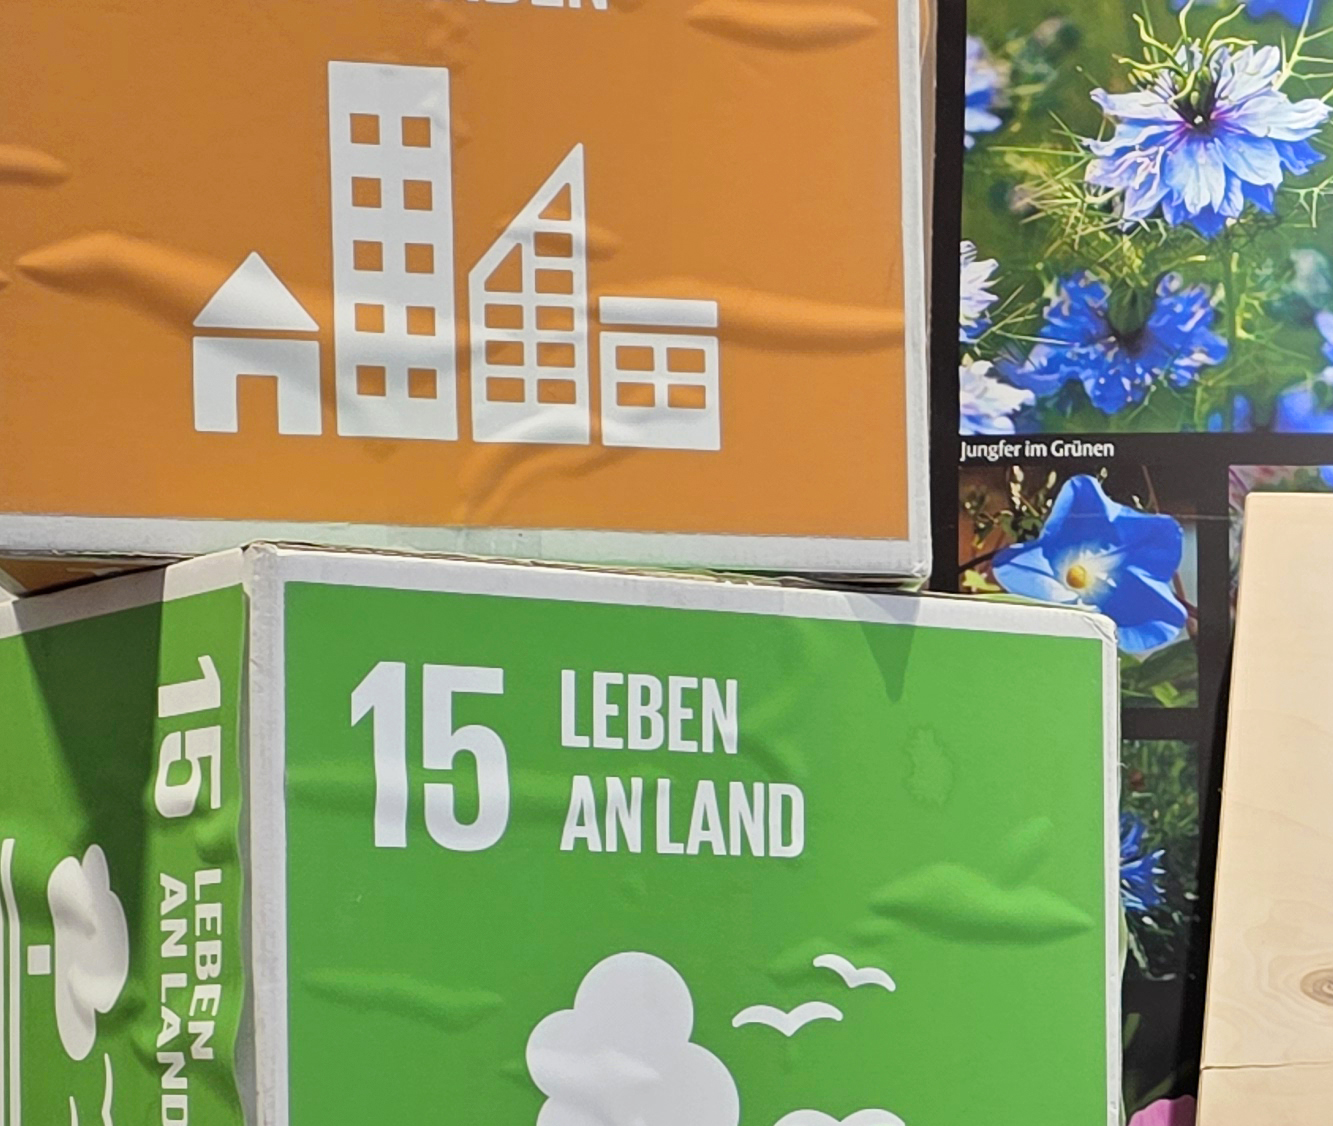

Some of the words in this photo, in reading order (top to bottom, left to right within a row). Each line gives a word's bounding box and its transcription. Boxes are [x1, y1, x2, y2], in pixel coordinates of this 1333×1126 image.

[960, 440, 1022, 462] Jungfer
[1025, 441, 1047, 457] im
[1050, 439, 1115, 458] Grünen
[155, 655, 222, 818] 15
[350, 661, 511, 852] 15
[561, 669, 739, 755] LEBEN
[559, 775, 643, 854] AN
[656, 777, 805, 858] LAND
[187, 869, 223, 1061] LEBEN
